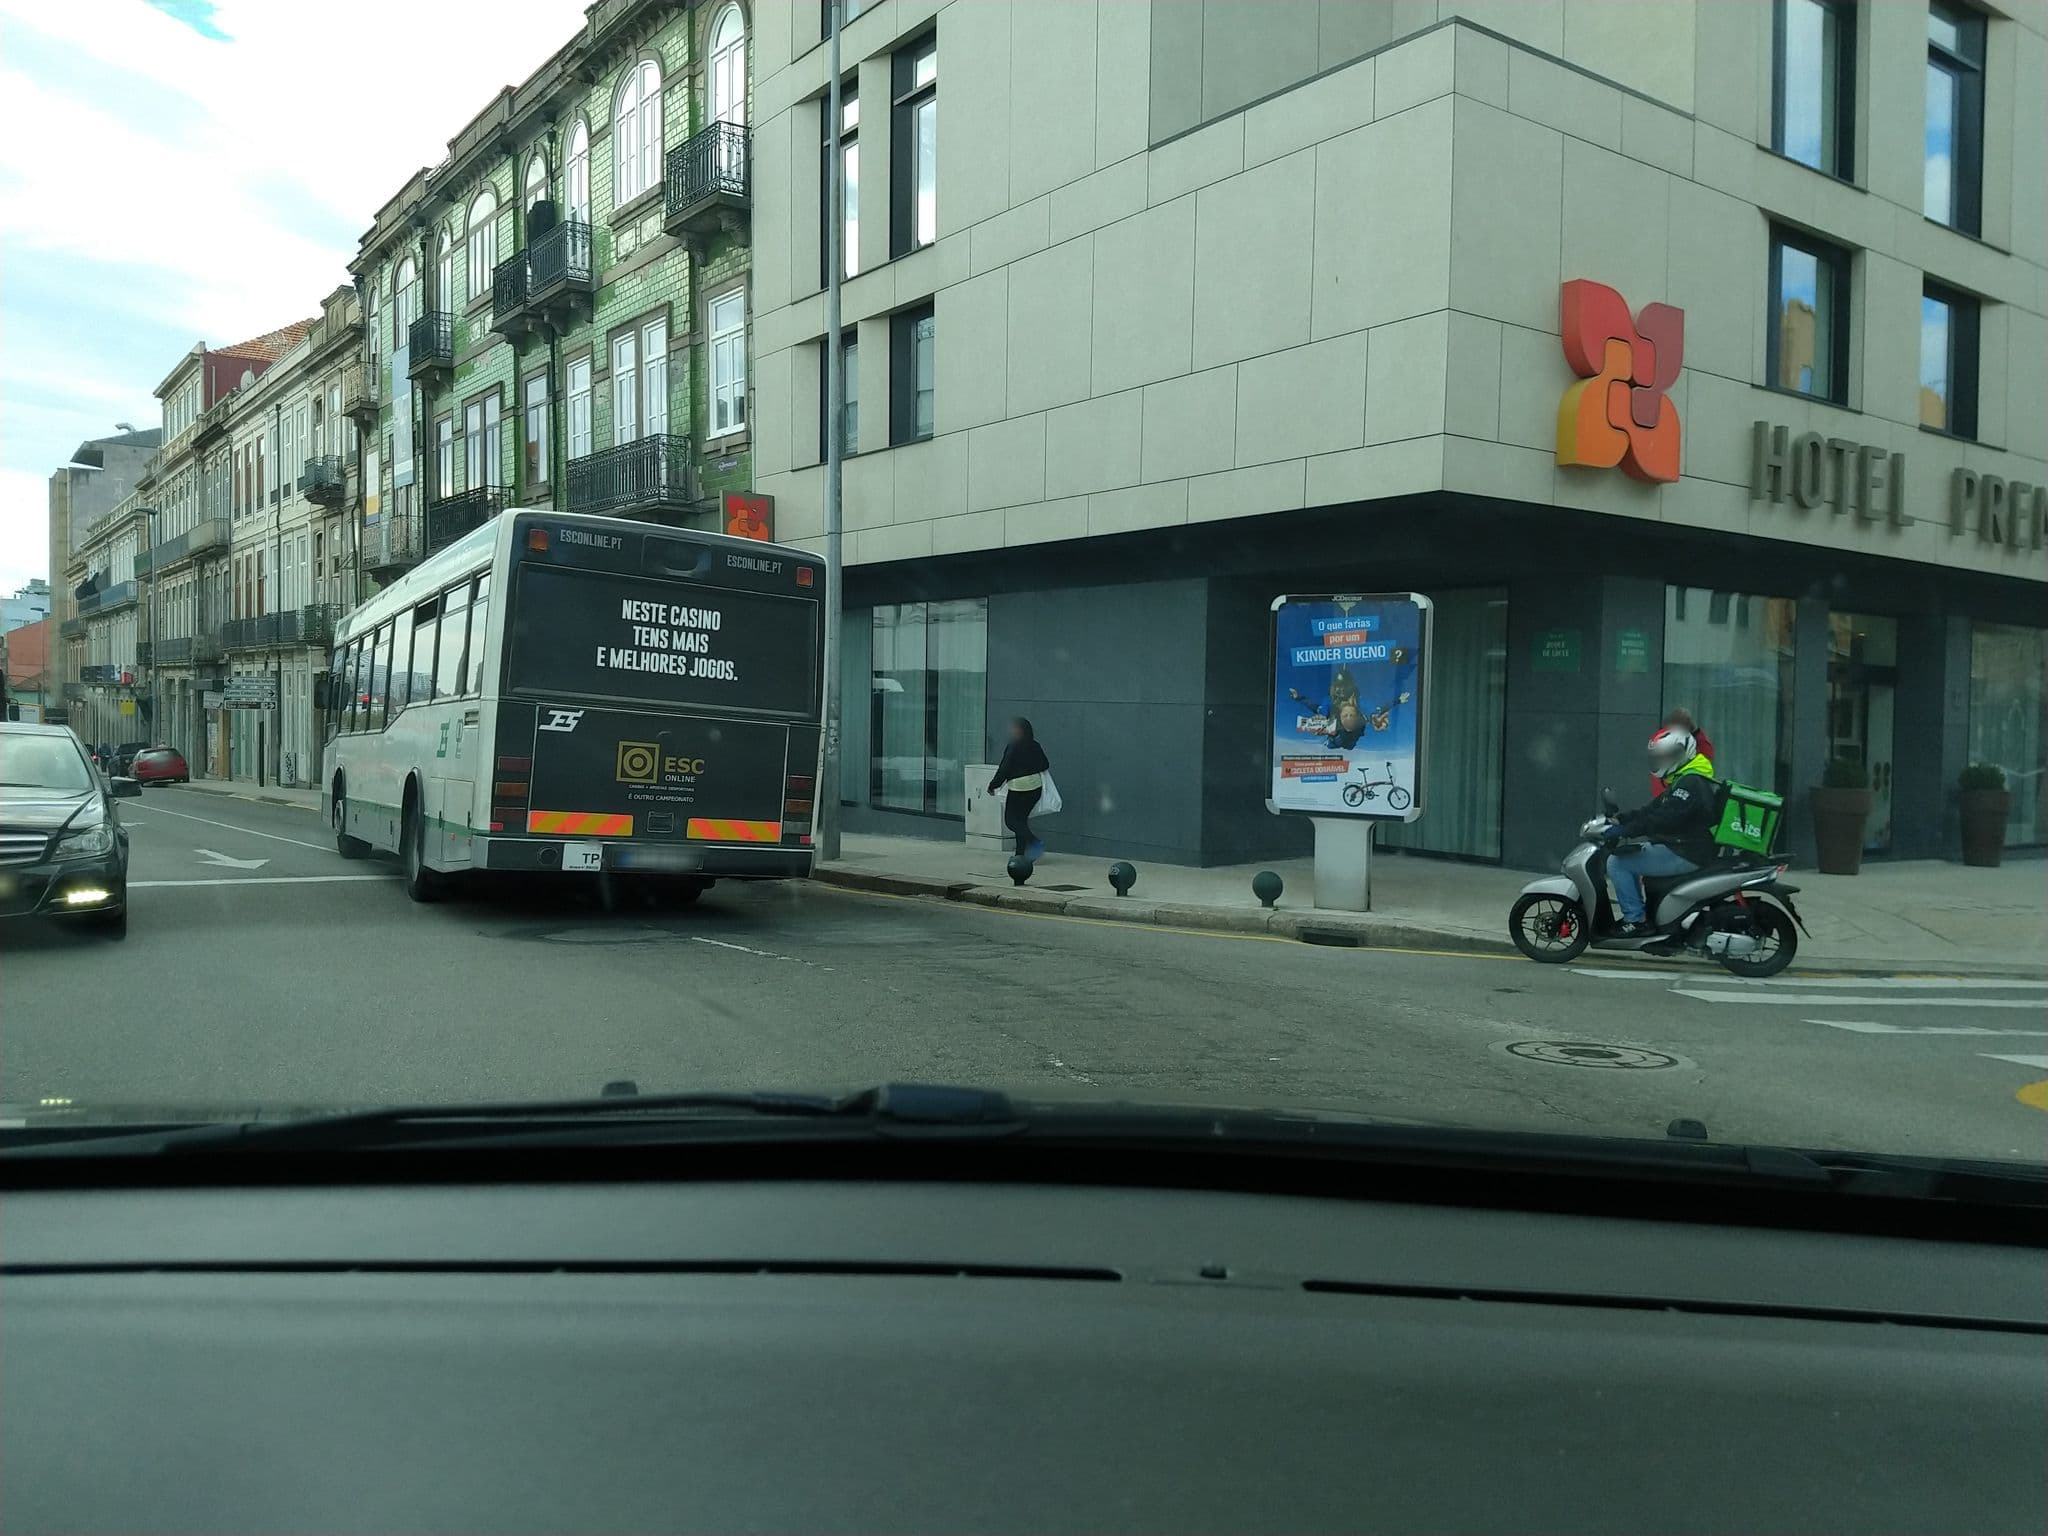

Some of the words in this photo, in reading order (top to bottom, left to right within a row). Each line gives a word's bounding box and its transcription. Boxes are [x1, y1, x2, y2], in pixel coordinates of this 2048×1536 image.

[1752, 420, 1914, 526] HOTEL
[560, 530, 623, 550] ESCONLINE.PT
[727, 555, 782, 574] ESCONLINE.PT
[622, 599, 667, 626] NESTE
[670, 606, 721, 631] CASINO
[1318, 621, 1325, 631] O
[1326, 621, 1343, 631] que
[1345, 619, 1371, 629] farias
[633, 626, 669, 649] TENS
[672, 631, 709, 654] MAIS
[1329, 635, 1344, 645] por
[1346, 633, 1360, 642] um
[1296, 648, 1341, 663] KINDER
[1344, 645, 1386, 660] BUENO
[597, 647, 606, 667] E
[609, 648, 686, 676] MELHORES
[689, 659, 738, 681] JOGOS.
[664, 756, 705, 775] ESC
[664, 774, 697, 783] ONLINE
[633, 793, 654, 801] OUTRO
[655, 795, 694, 803] CAMPEONATO
[582, 852, 600, 864] TP
